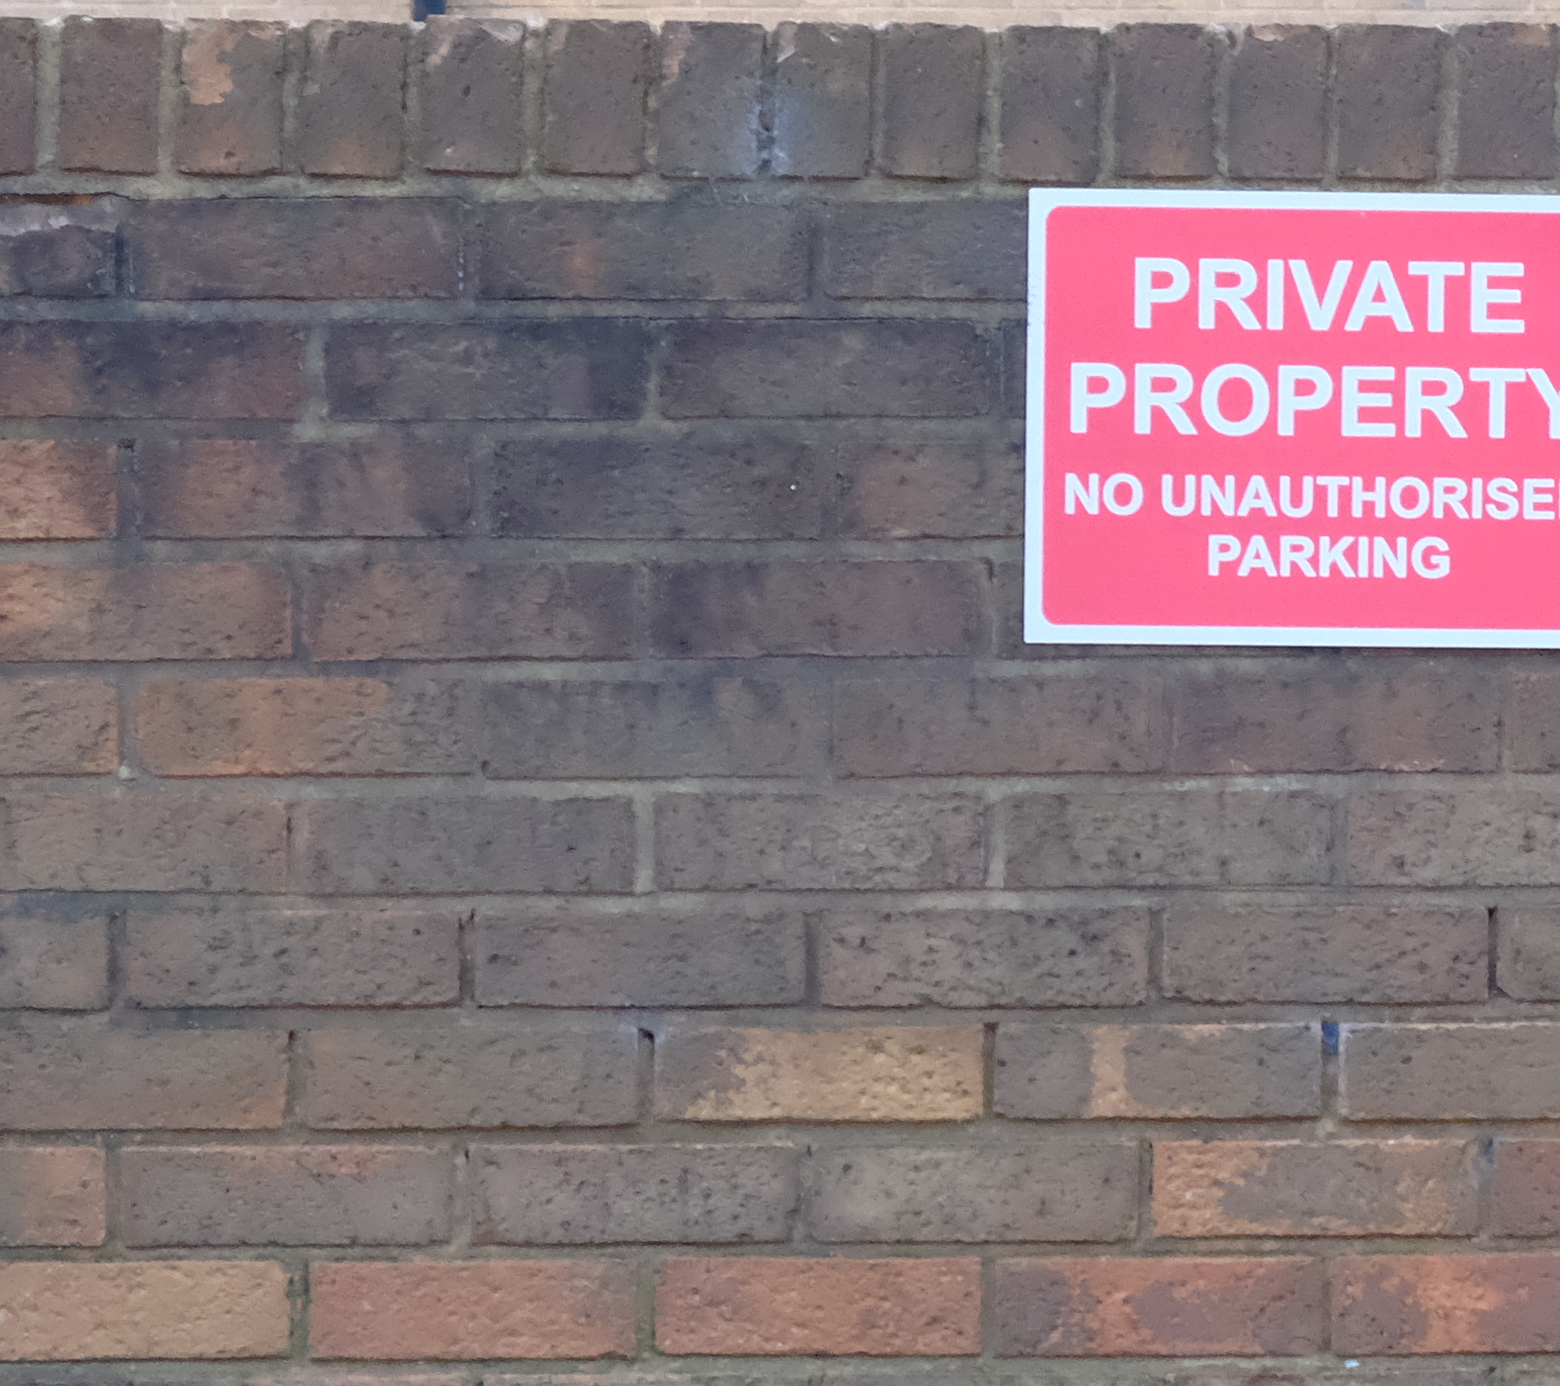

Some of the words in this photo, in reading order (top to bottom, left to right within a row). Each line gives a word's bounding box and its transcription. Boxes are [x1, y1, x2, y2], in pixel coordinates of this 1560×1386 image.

[1134, 256, 1526, 334] PRIVATE
[1063, 472, 1144, 516] NO
[1207, 534, 1451, 580] PARKING
